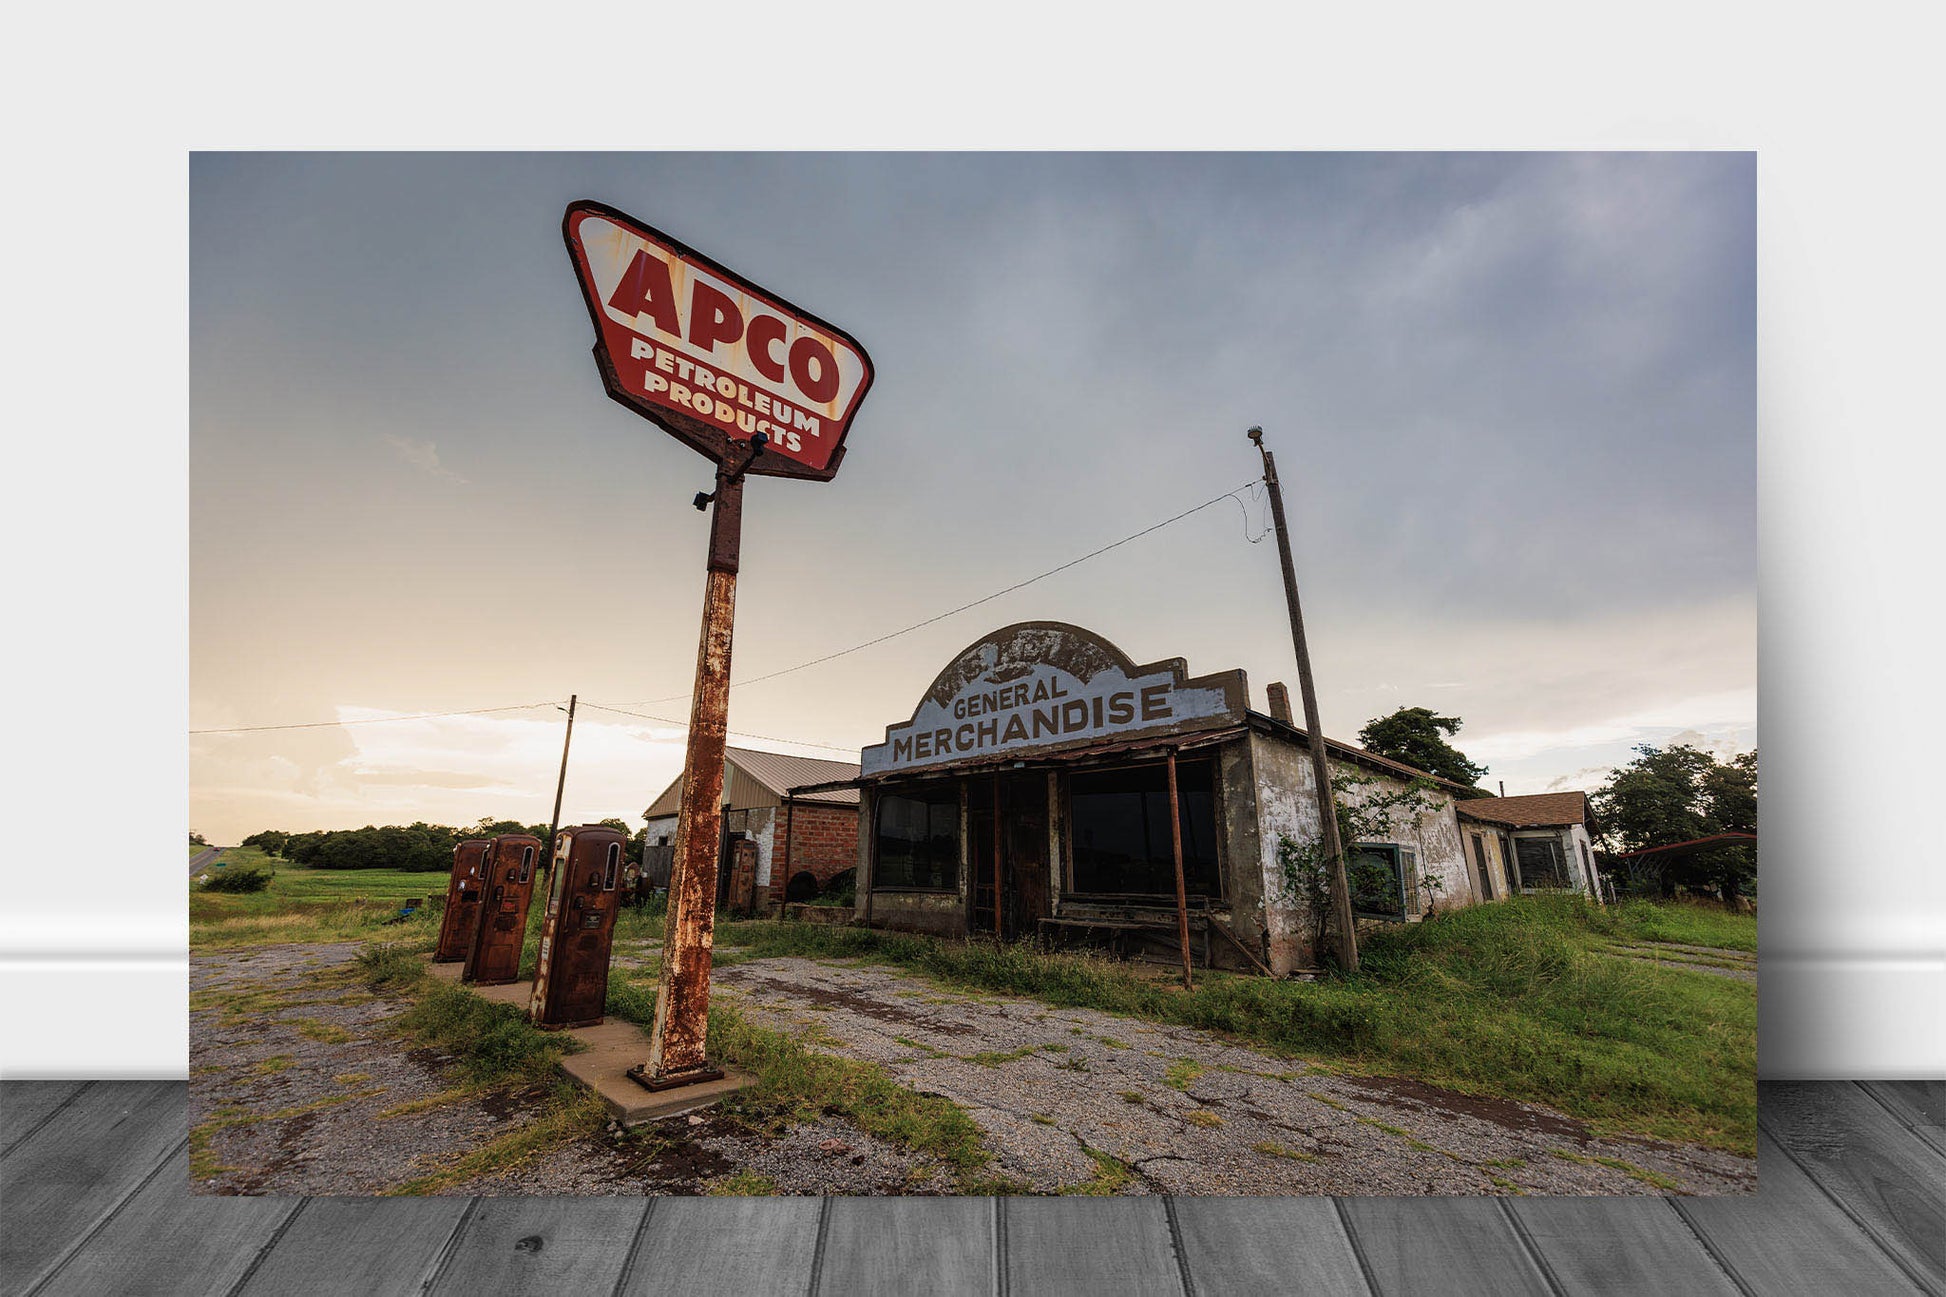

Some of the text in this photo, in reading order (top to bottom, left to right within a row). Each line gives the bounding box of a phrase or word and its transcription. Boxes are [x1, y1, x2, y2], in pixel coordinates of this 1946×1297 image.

[607, 248, 840, 403] APCO
[630, 337, 820, 437] PETROLEUM
[644, 370, 802, 452] PRODUCTS
[893, 684, 1173, 762] MERCHANDISE
[953, 676, 1068, 720] GENERAL
